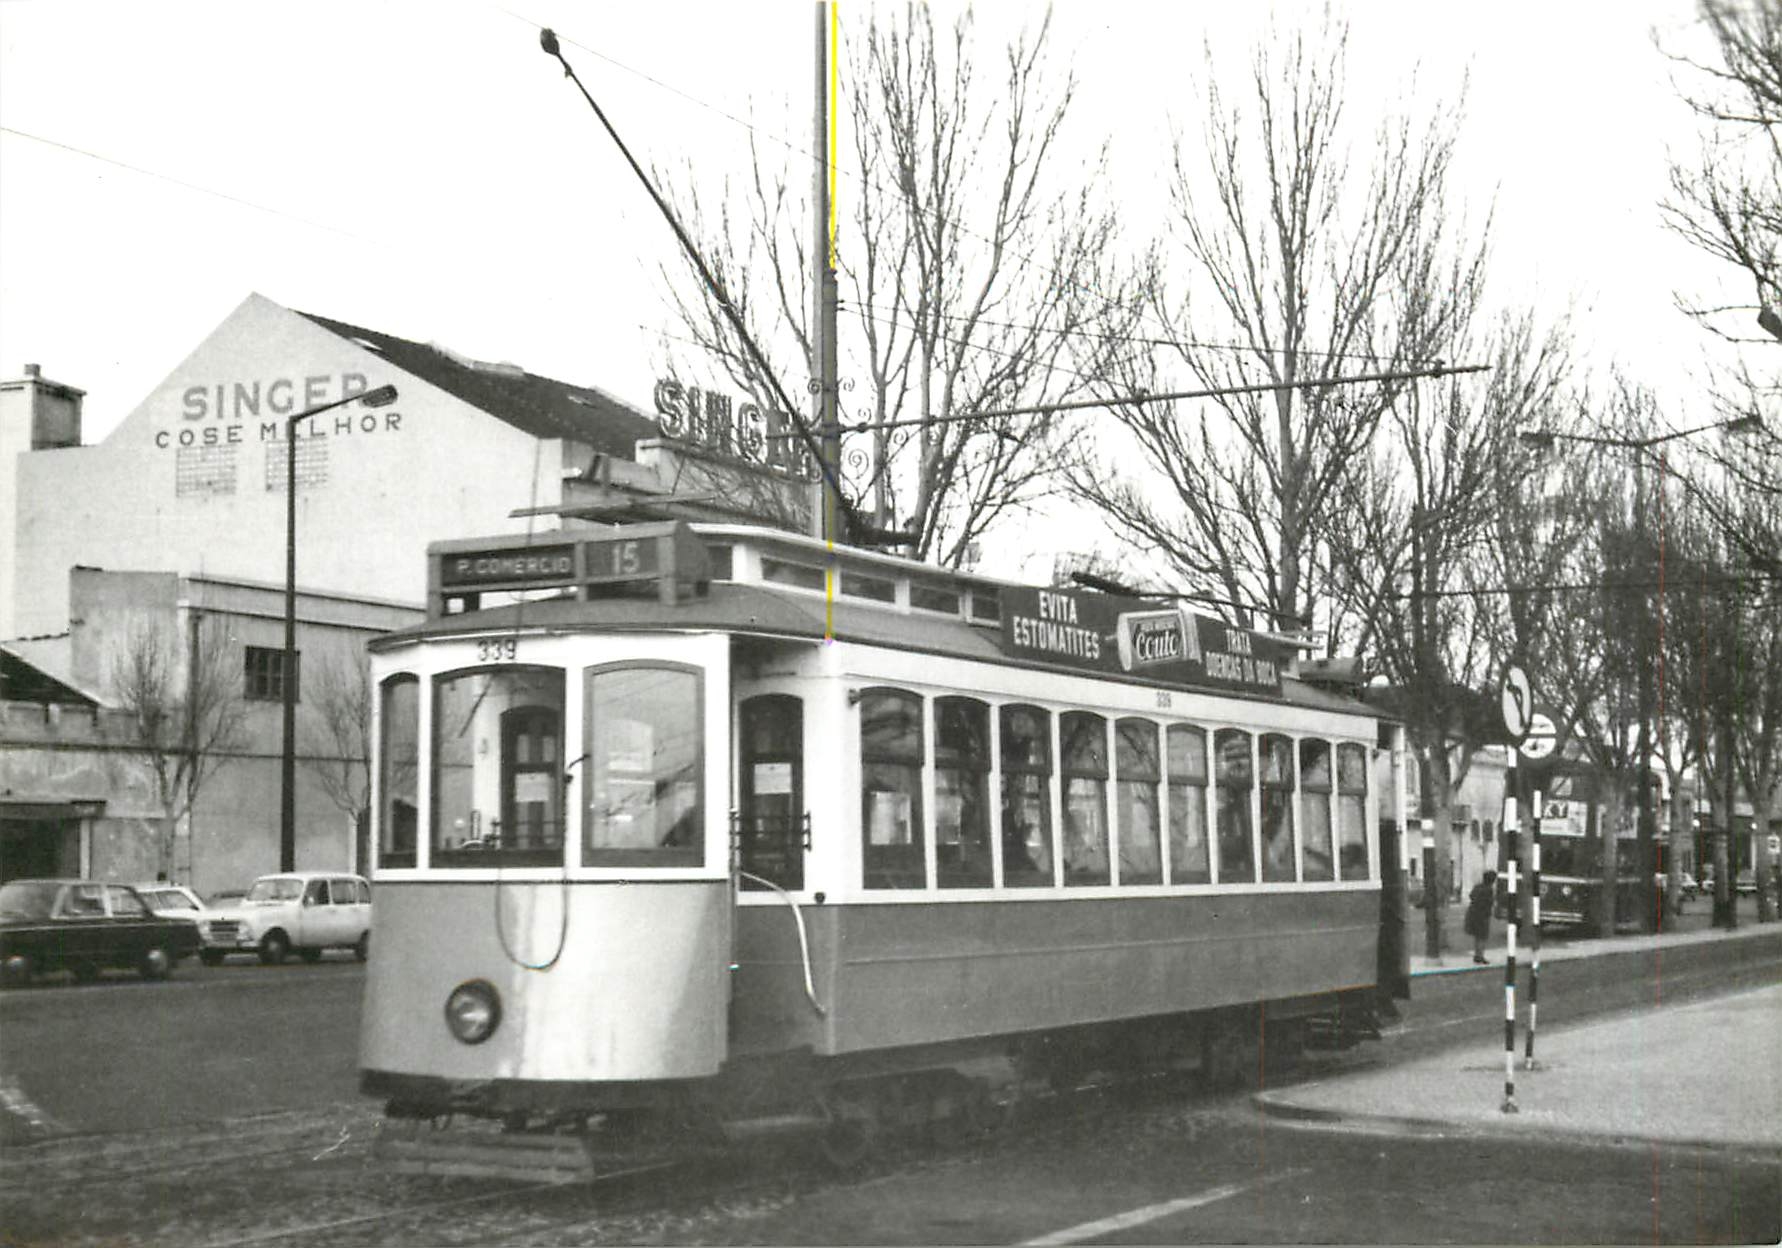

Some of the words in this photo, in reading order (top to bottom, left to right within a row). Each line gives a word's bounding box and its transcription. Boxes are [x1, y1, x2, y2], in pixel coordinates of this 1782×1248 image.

[182, 372, 368, 421] SINGER
[155, 425, 243, 449] COSE
[613, 541, 640, 575] 15
[1038, 591, 1078, 624] EVITA
[477, 639, 517, 661] 339
[1013, 616, 1100, 660] ESTOMATITES
